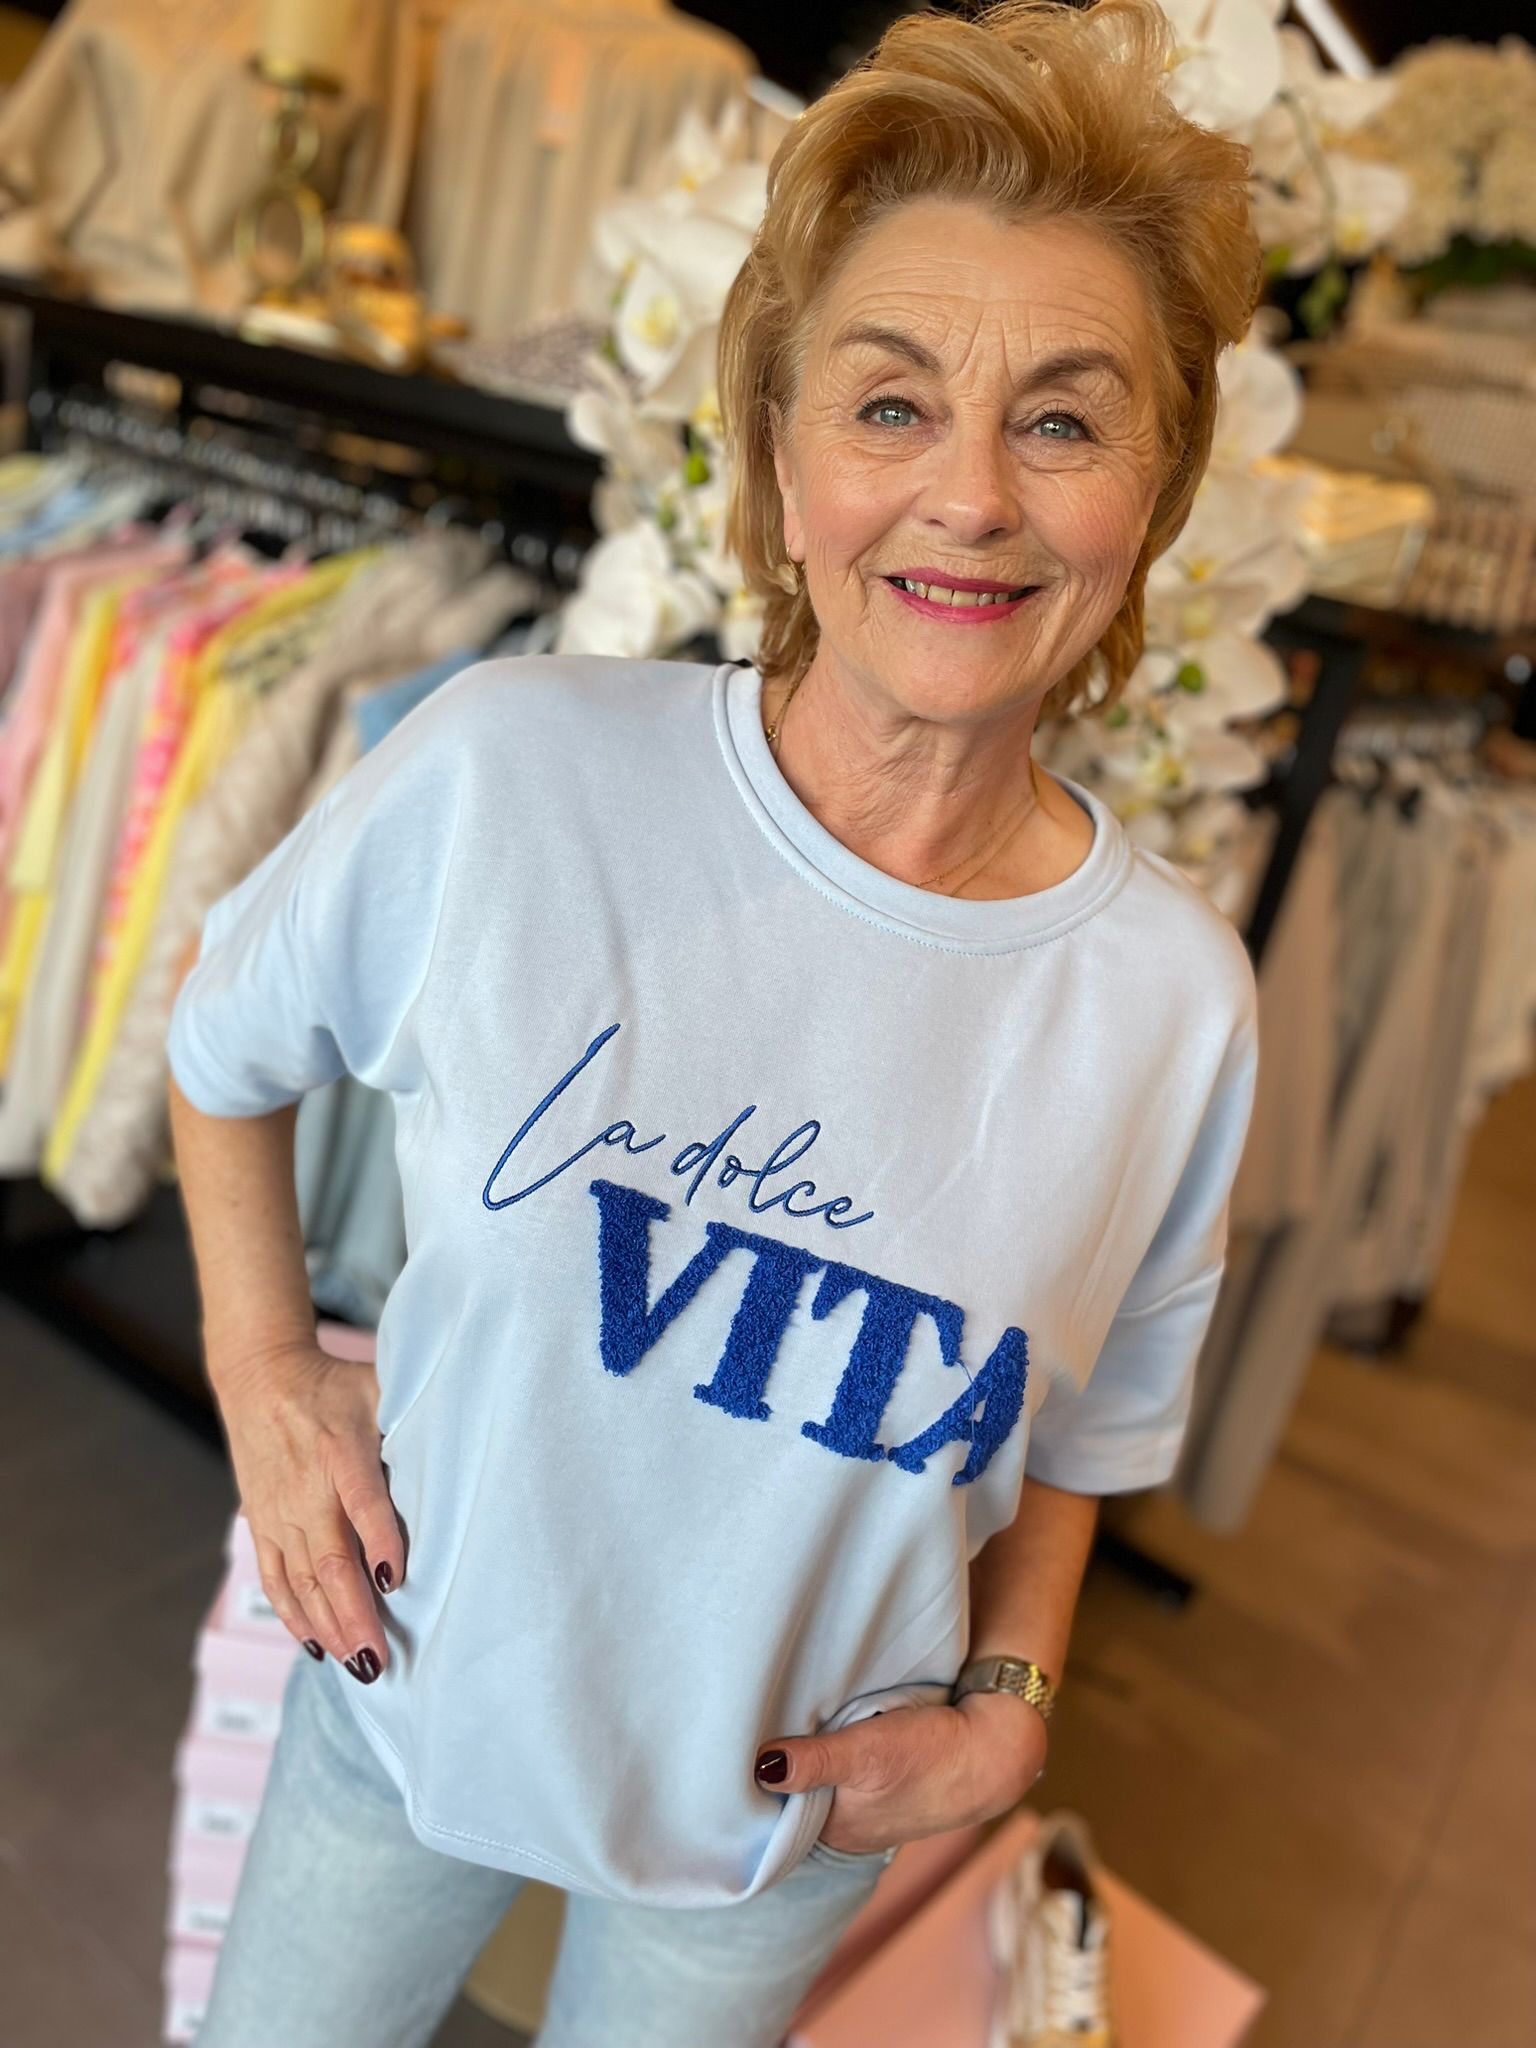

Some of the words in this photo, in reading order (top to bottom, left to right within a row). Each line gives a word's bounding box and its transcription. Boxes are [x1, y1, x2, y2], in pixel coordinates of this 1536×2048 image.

[482, 1023, 666, 1211] La
[670, 1105, 875, 1229] dolce
[589, 1179, 1029, 1486] VITA
